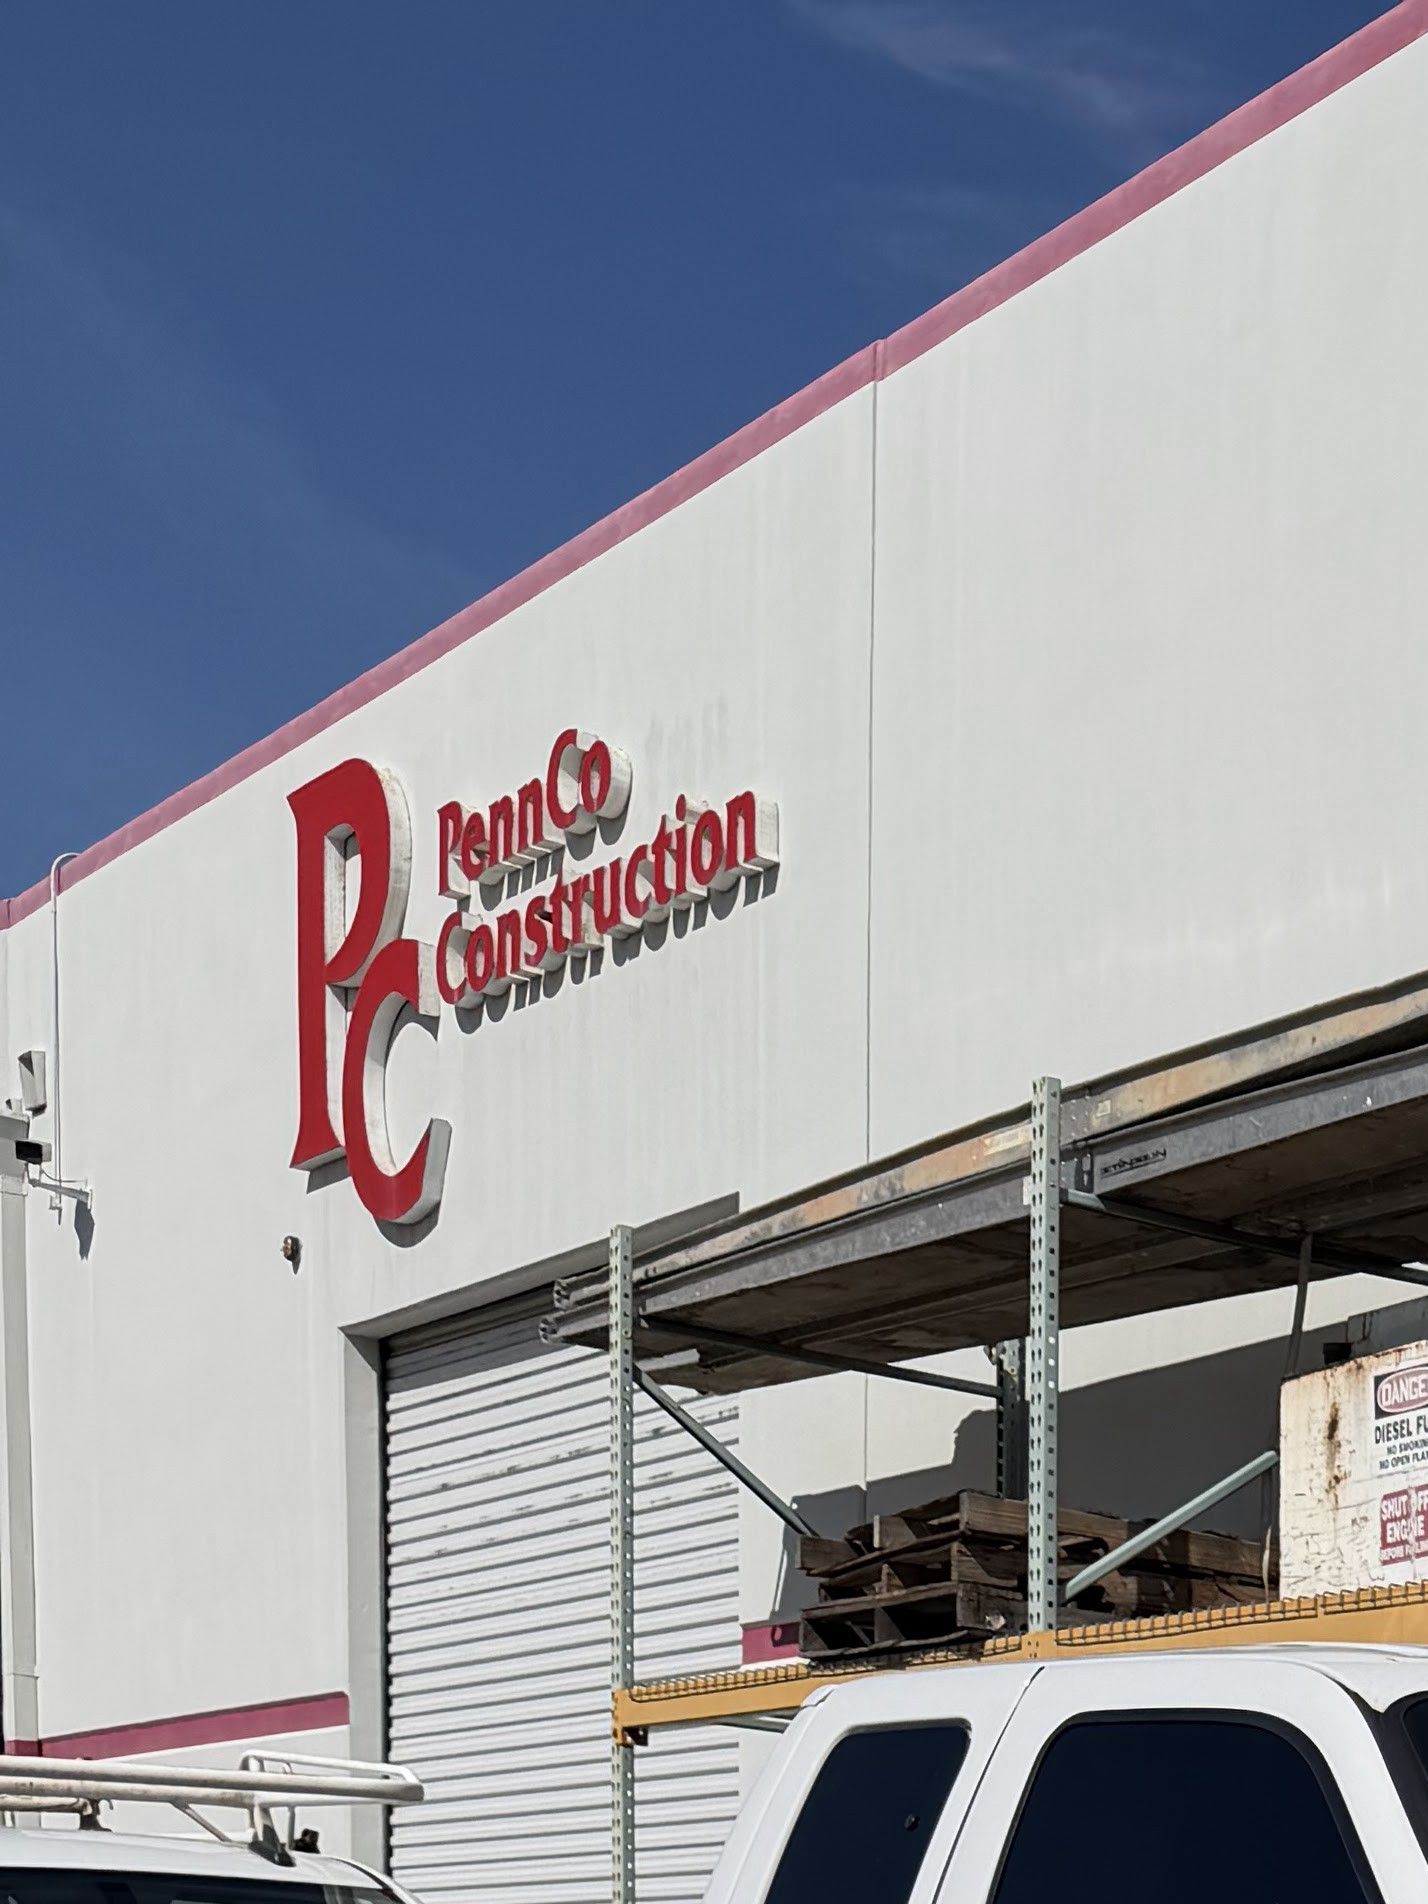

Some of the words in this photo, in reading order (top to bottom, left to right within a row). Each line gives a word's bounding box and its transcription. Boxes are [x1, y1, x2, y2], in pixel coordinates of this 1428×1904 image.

[437, 728, 614, 898] PennCo
[436, 790, 760, 1005] Construction
[1375, 1418, 1413, 1445] DIESEL
[1391, 1454, 1411, 1468] OPEN
[1382, 1494, 1408, 1521] SHUT
